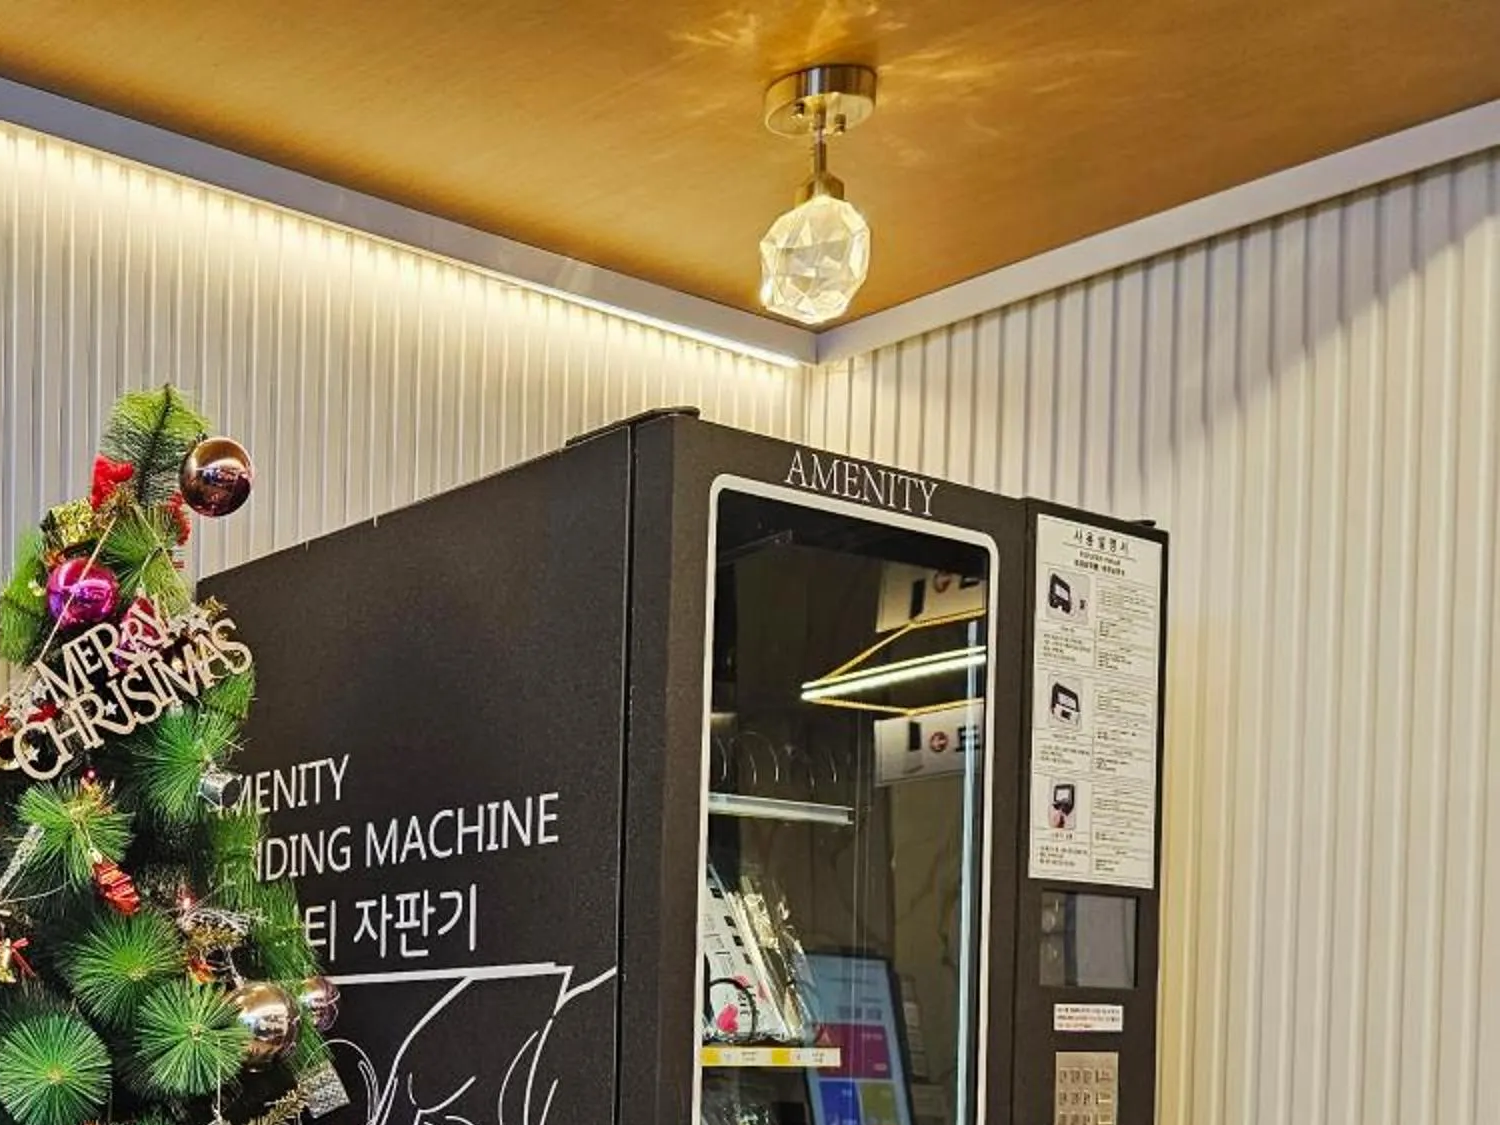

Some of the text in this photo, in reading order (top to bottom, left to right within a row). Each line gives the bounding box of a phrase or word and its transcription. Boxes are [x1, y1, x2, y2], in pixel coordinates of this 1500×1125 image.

[783, 449, 938, 517] AMENITY
[13, 618, 253, 780] CHRISTMAS
[33, 602, 174, 708] MERRY
[256, 792, 560, 883] DING MACHINE
[353, 883, 478, 960] 자판기
